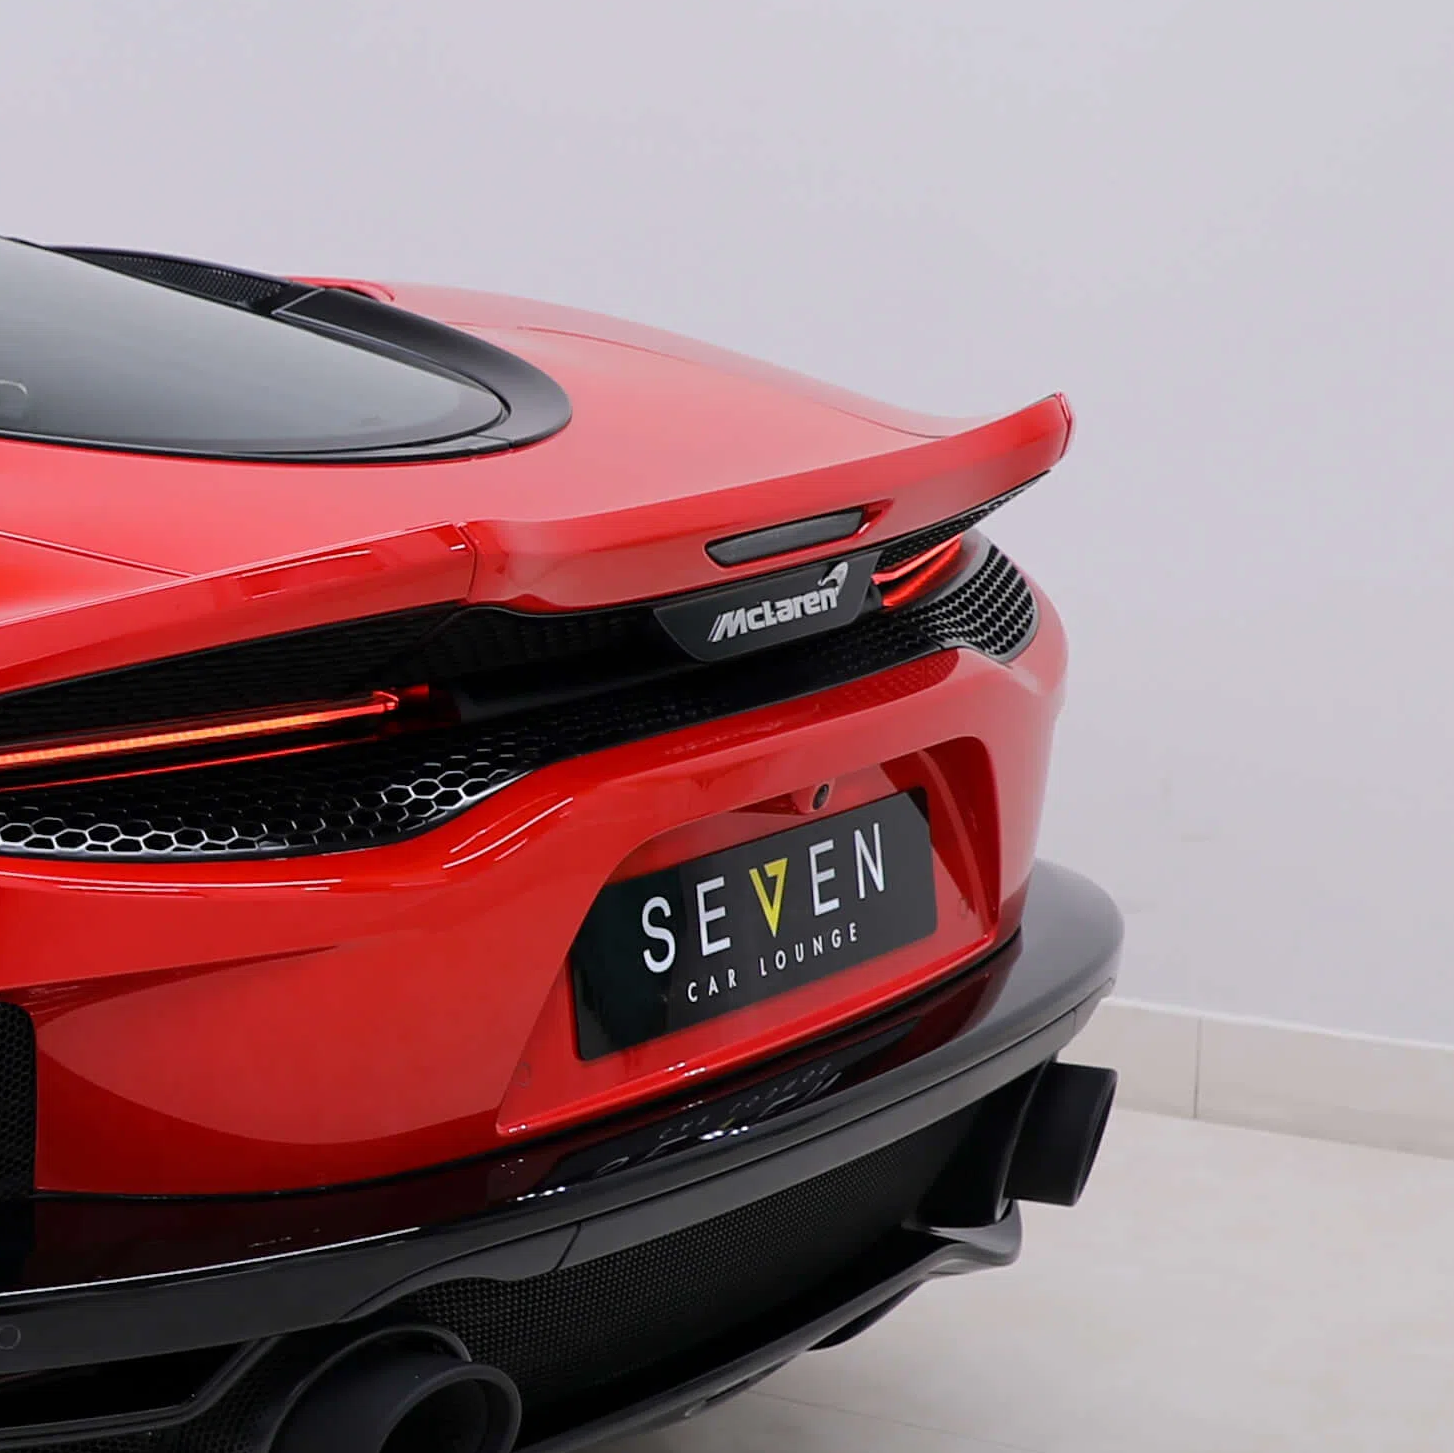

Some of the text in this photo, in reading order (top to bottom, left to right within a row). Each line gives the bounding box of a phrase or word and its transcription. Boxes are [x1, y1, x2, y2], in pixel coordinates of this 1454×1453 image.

[708, 583, 841, 642] McLaren
[640, 822, 886, 974] SEVEN
[687, 922, 859, 1004] CAR LOUNGE
